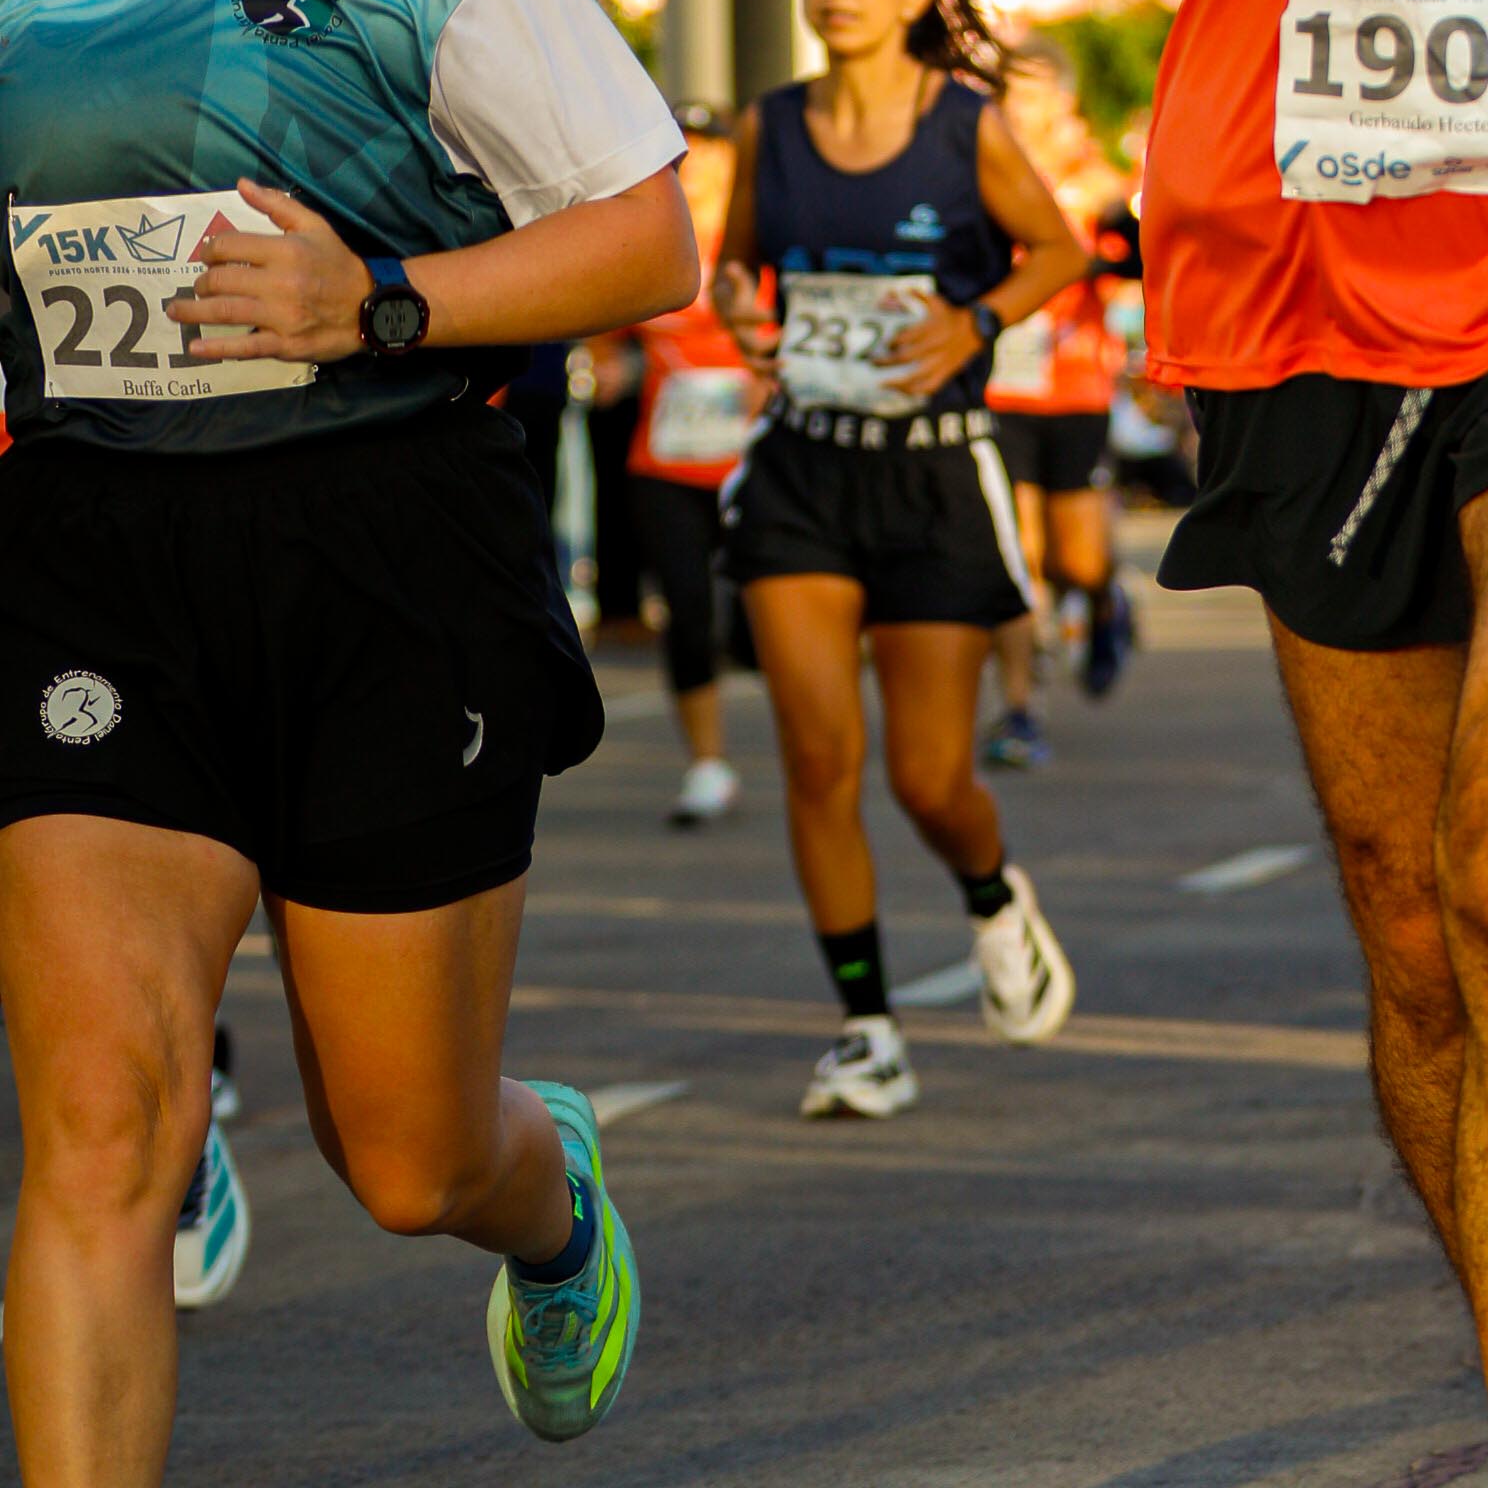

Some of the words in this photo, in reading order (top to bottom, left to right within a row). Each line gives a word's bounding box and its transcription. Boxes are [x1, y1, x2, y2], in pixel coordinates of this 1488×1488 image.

[1349, 111, 1432, 130] Gerbaudo
[1317, 151, 1411, 185] osde
[37, 226, 117, 264] 15K
[49, 268, 82, 277] PUERTO
[137, 267, 171, 275] ROSARIO
[180, 266, 189, 274] 12
[123, 379, 163, 396] Buffa
[168, 379, 212, 396] Carla
[42, 685, 54, 698] de
[54, 669, 124, 710] Entrenamiento
[40, 702, 56, 735] Grupo
[94, 713, 122, 742] Daniel
[55, 732, 91, 745] Penta
